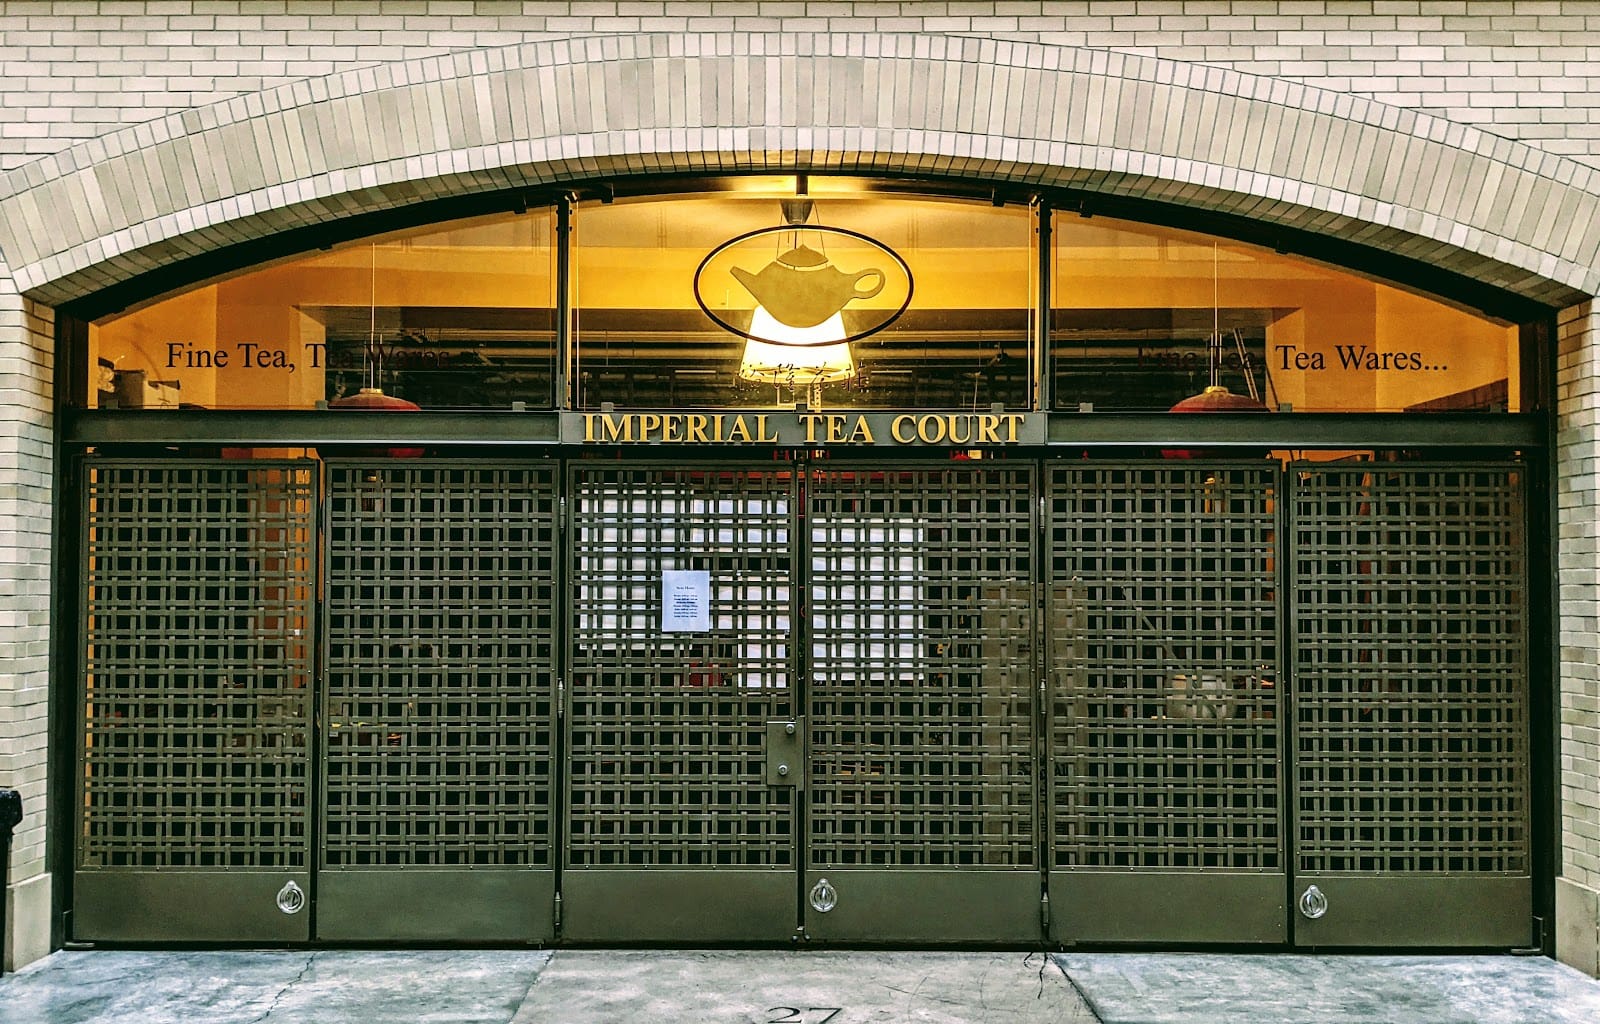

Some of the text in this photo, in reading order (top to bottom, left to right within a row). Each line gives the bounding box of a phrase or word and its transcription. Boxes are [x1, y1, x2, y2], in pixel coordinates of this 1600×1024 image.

[165, 342, 228, 368] Fine
[237, 343, 295, 374] Tea,
[305, 343, 353, 369] Tea
[1275, 345, 1326, 370] Tea
[1335, 345, 1448, 370] Wares...
[582, 413, 1025, 444] IMPERIAL TEA COURT
[767, 1006, 842, 1024] 27
